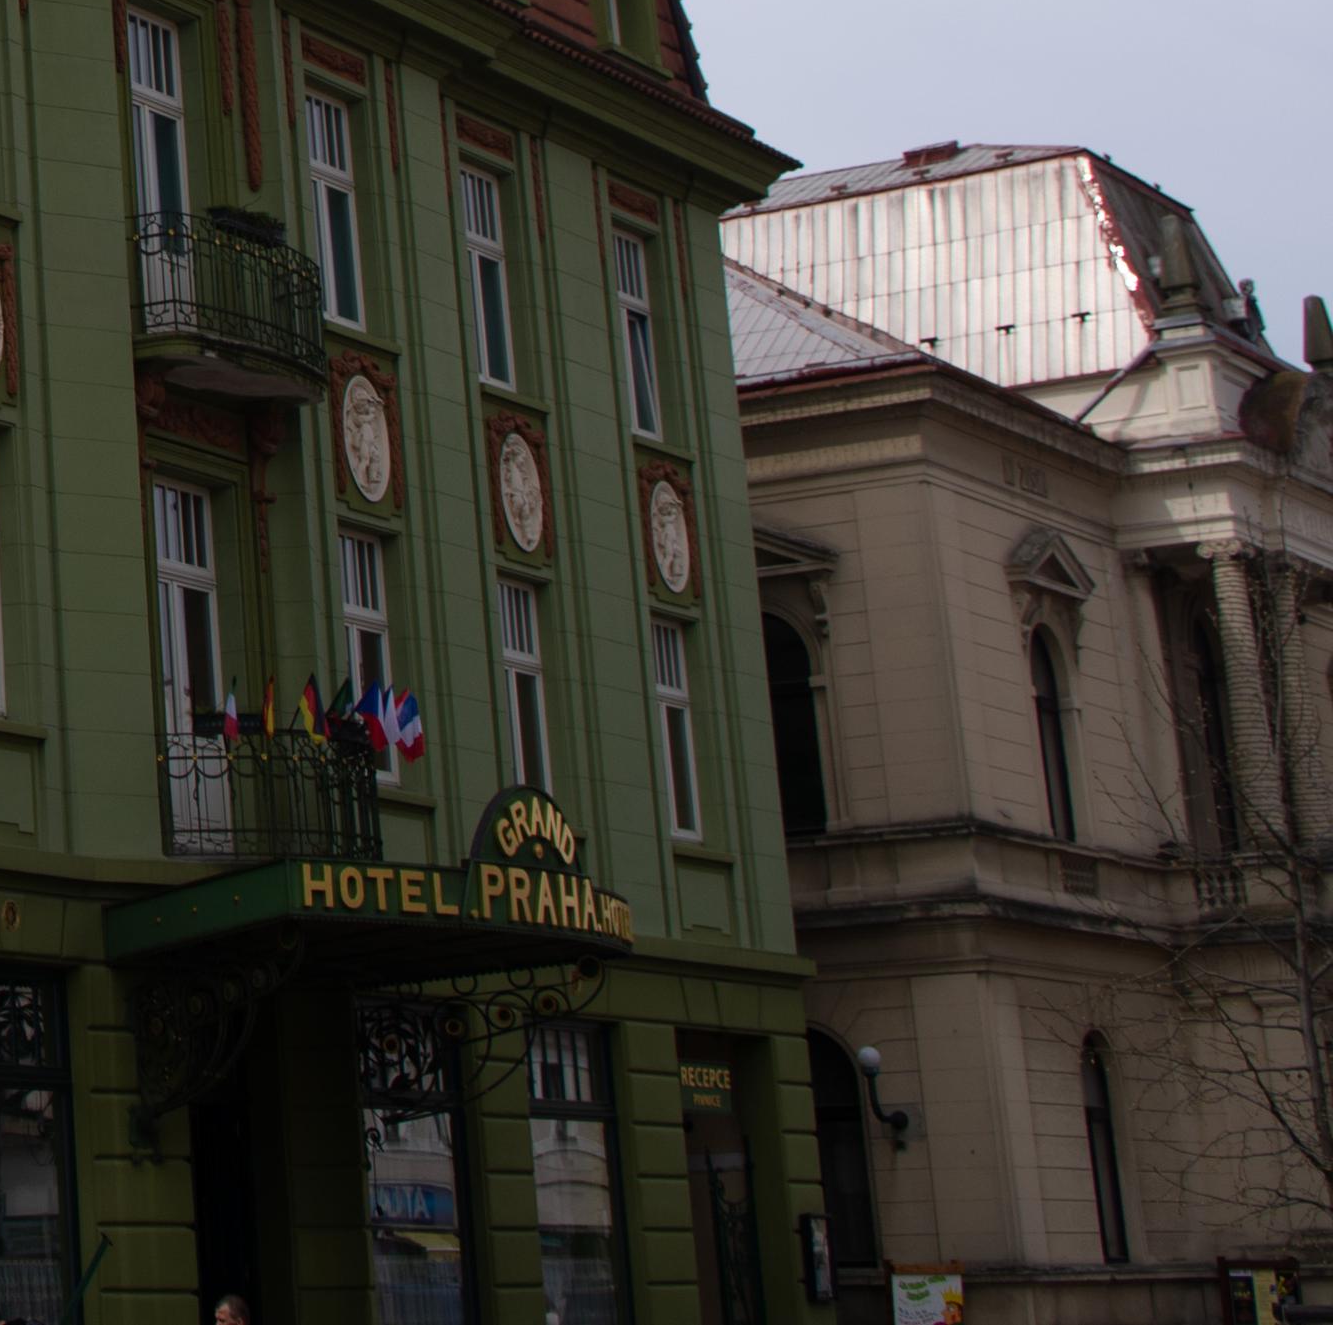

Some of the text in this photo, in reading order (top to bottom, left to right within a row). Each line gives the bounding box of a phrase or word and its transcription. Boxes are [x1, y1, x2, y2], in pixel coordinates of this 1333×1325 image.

[496, 797, 575, 865] GRAND
[302, 863, 597, 932] HOTEL PRAHA
[680, 1066, 731, 1090] RECEPCE
